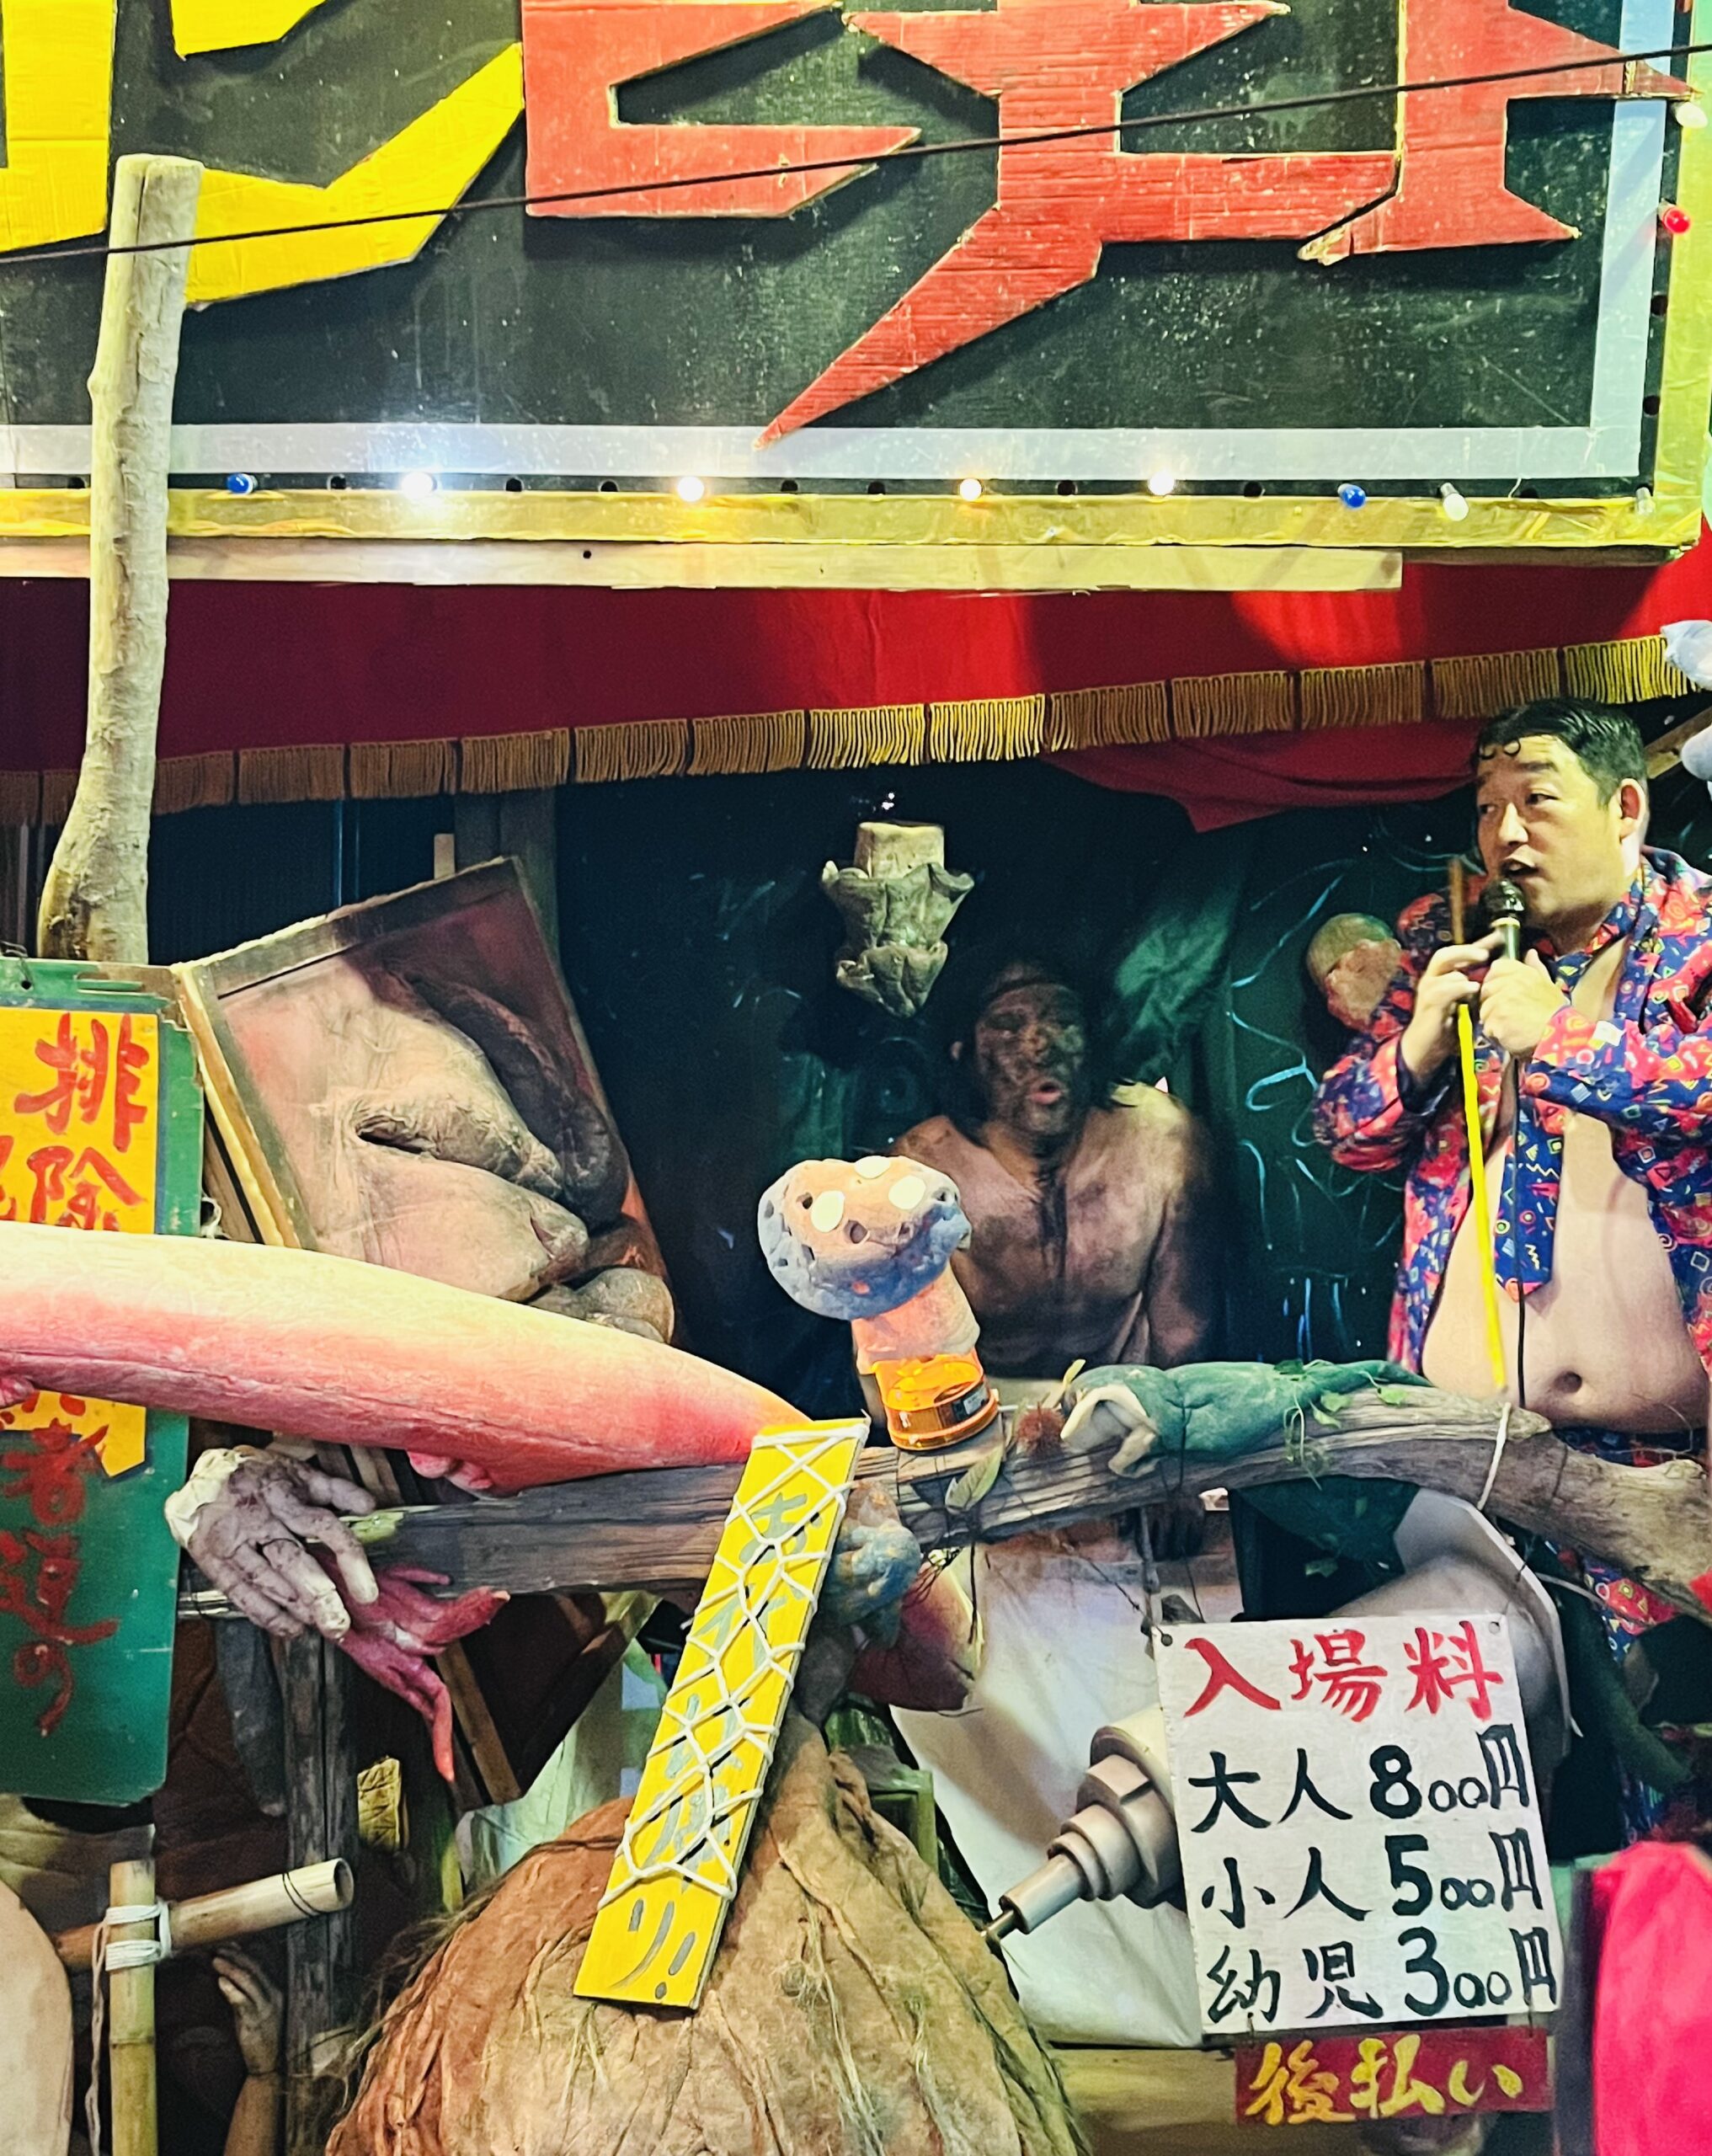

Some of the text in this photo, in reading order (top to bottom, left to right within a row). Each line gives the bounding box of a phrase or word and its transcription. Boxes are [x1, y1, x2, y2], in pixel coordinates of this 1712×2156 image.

[1182, 1620, 1505, 1723] 入場料
[1187, 1723, 1531, 1833] 大人 800円
[1201, 1828, 1544, 1929] 小人 500円
[1207, 1926, 1558, 2023] 幼児 300円
[1245, 2033, 1523, 2127] 後払い
